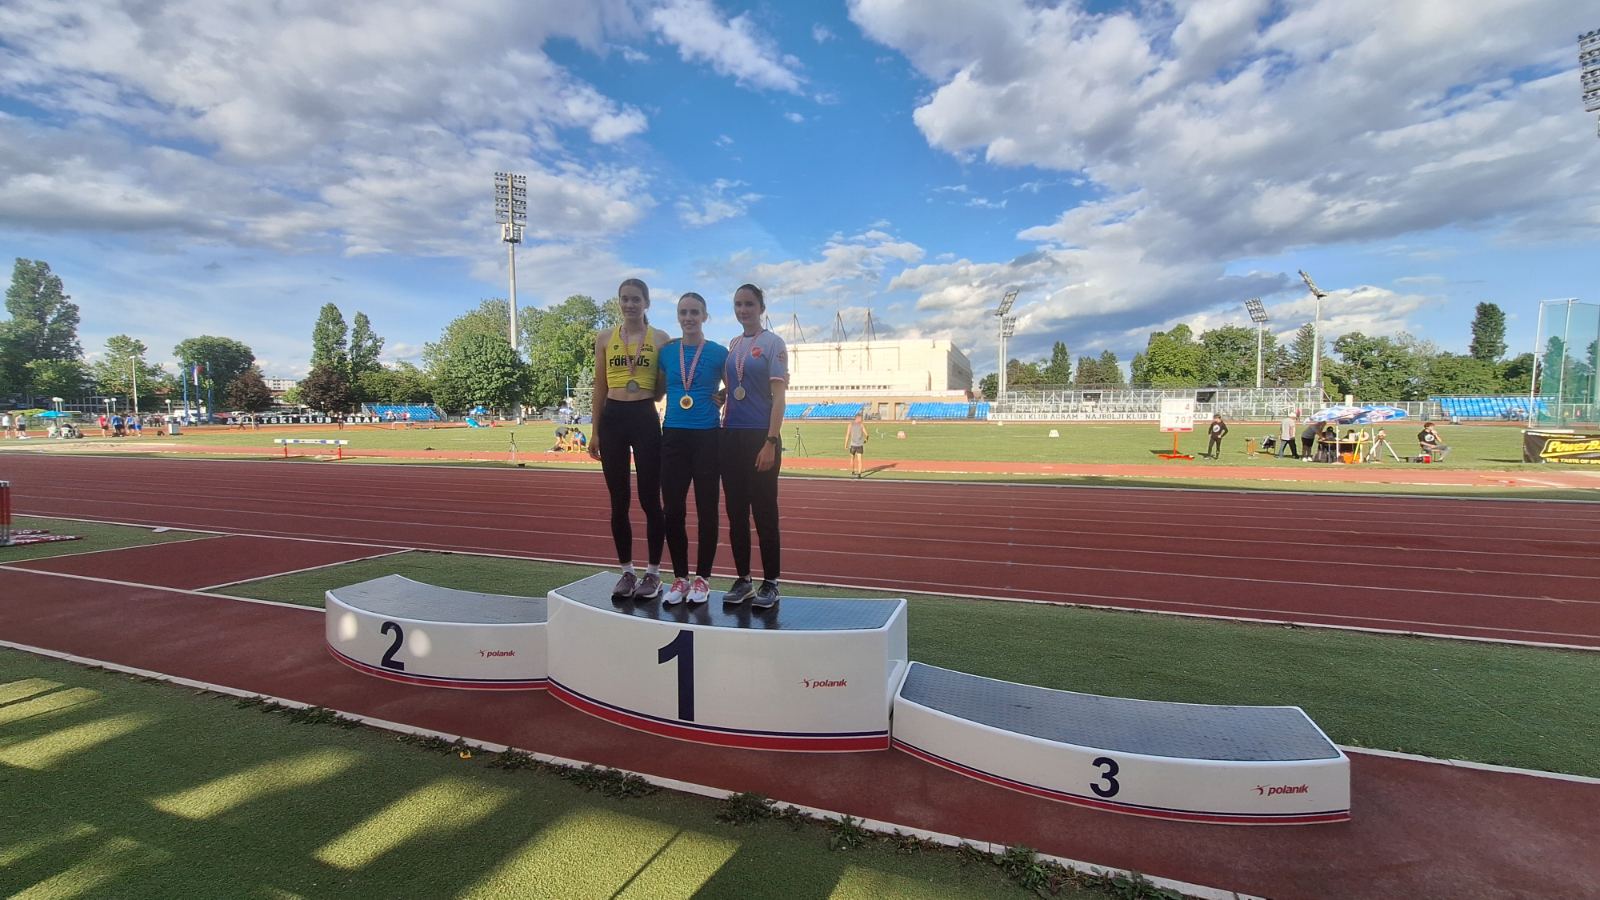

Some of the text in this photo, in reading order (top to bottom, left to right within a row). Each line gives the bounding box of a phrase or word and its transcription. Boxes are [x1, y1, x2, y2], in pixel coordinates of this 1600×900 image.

[380, 621, 404, 671] 2
[486, 650, 516, 658] polanik
[658, 630, 694, 722] 1
[812, 678, 847, 688] polanik
[1090, 756, 1120, 798] 3
[1268, 784, 1308, 796] polanik
